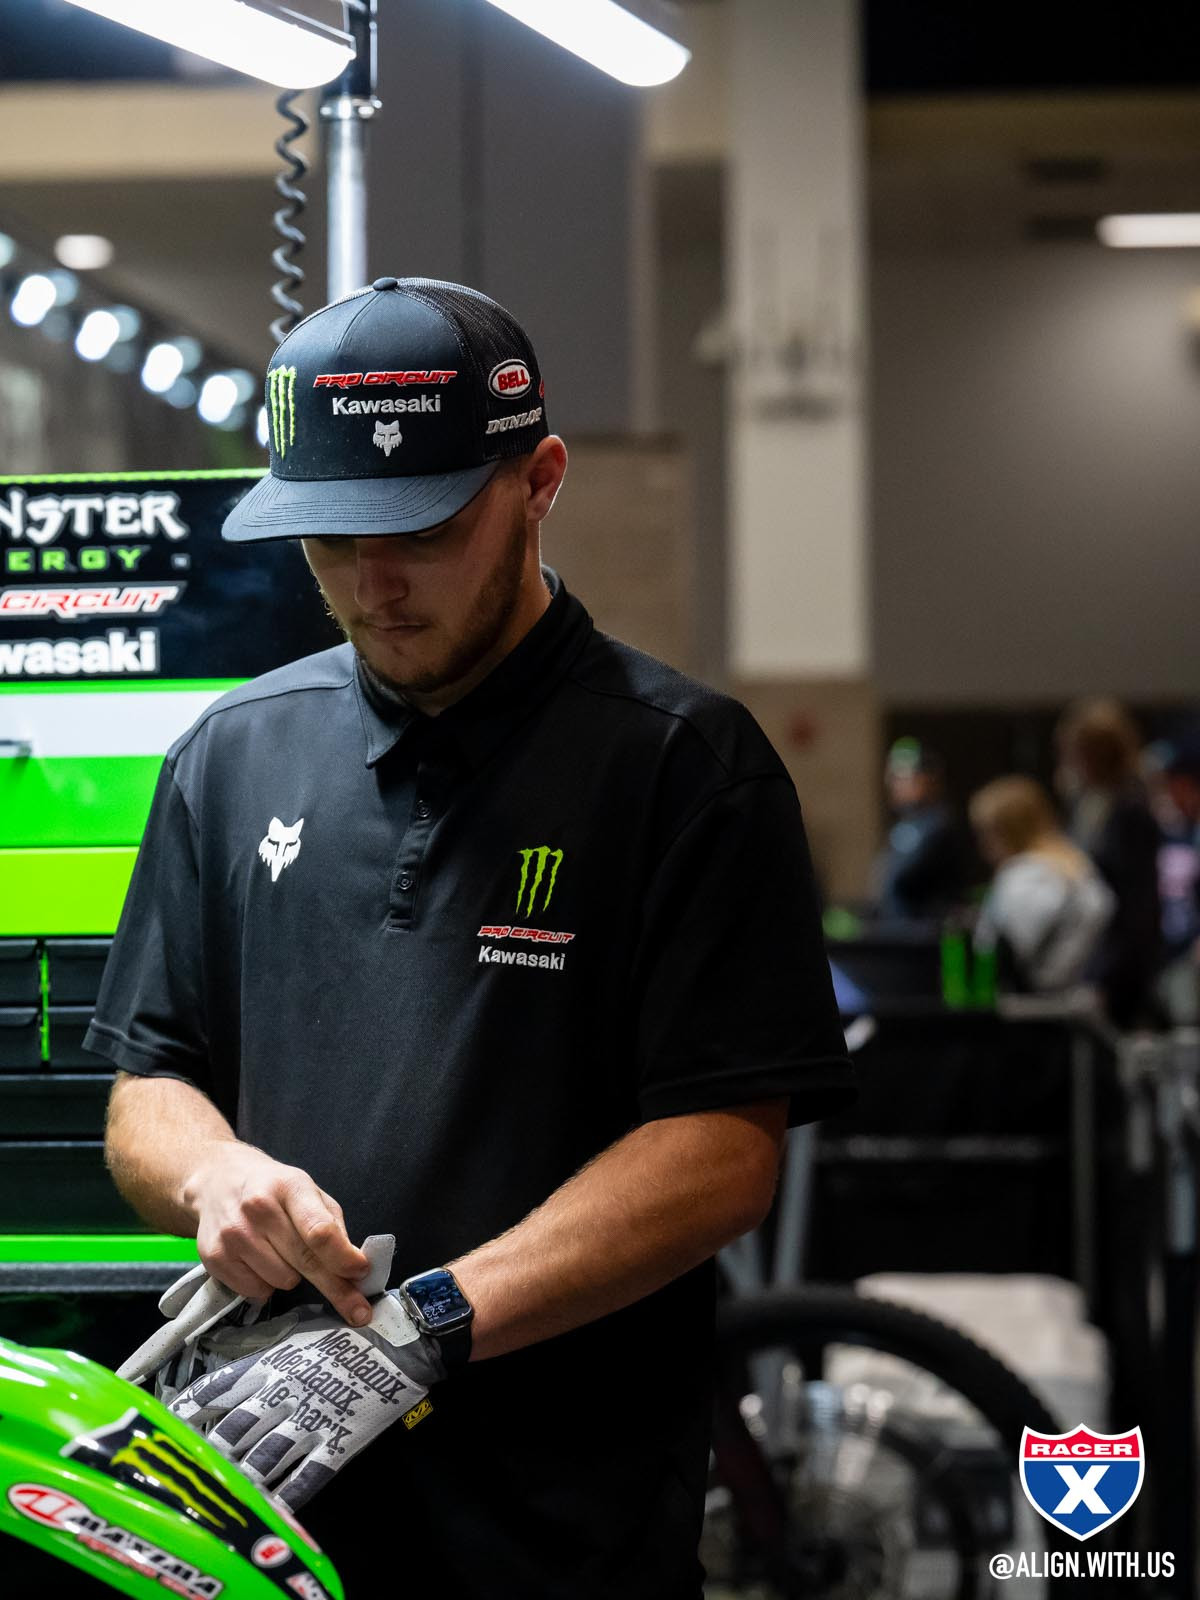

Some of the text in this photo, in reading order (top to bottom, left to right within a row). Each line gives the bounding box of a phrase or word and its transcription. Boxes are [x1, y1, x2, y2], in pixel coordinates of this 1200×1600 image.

[313, 370, 458, 389] PRO CIRCUIT
[497, 369, 529, 391] BELL
[332, 394, 441, 416] Kawasaki
[485, 406, 543, 434] DUNLOP
[477, 925, 576, 944] PRO CIRCUIT
[478, 945, 566, 971] Kawasaki
